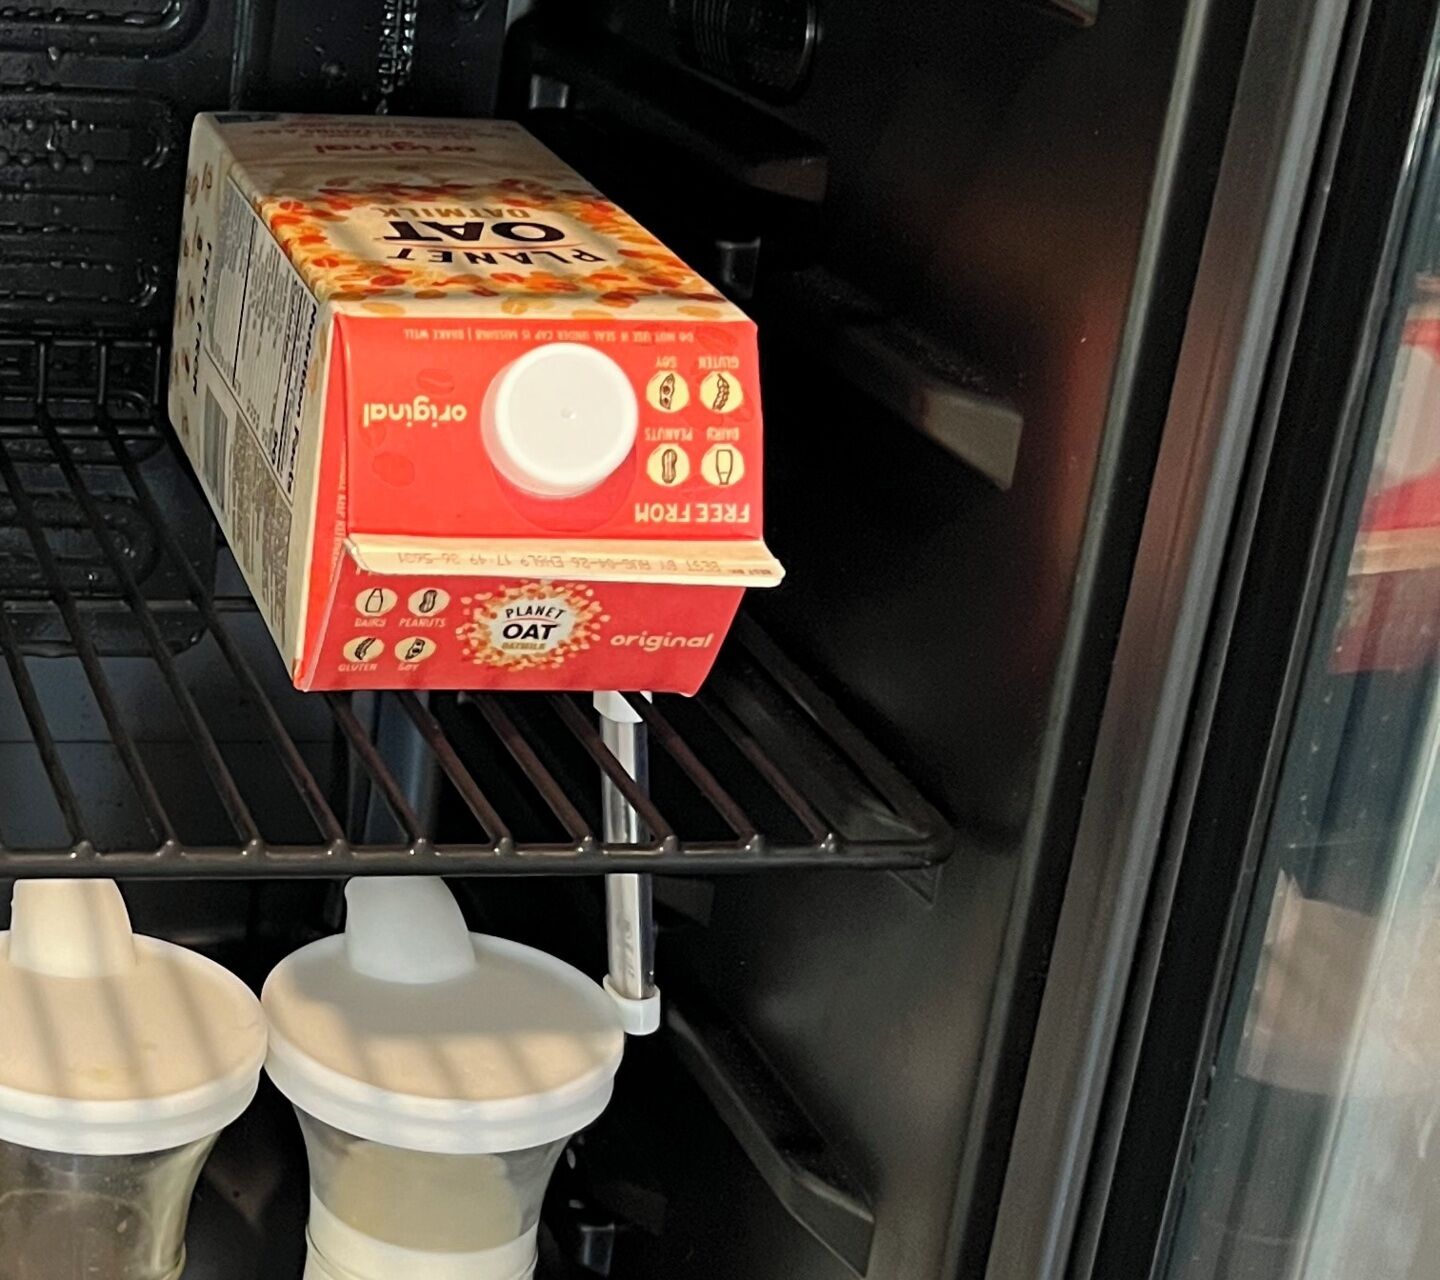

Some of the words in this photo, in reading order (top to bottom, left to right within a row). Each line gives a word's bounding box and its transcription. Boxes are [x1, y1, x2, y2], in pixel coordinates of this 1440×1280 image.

[376, 207, 530, 220] OATMILK
[383, 221, 566, 243] OAT
[386, 247, 606, 265] PLANET
[697, 355, 740, 370] GLUTEN
[363, 396, 468, 427] original
[644, 426, 694, 442] PEANUTS
[634, 503, 692, 524] FROM
[695, 503, 750, 524] FREE
[687, 558, 722, 573] BEST
[505, 606, 567, 621] PLANET
[502, 623, 558, 641] OAT
[610, 632, 714, 653] original
